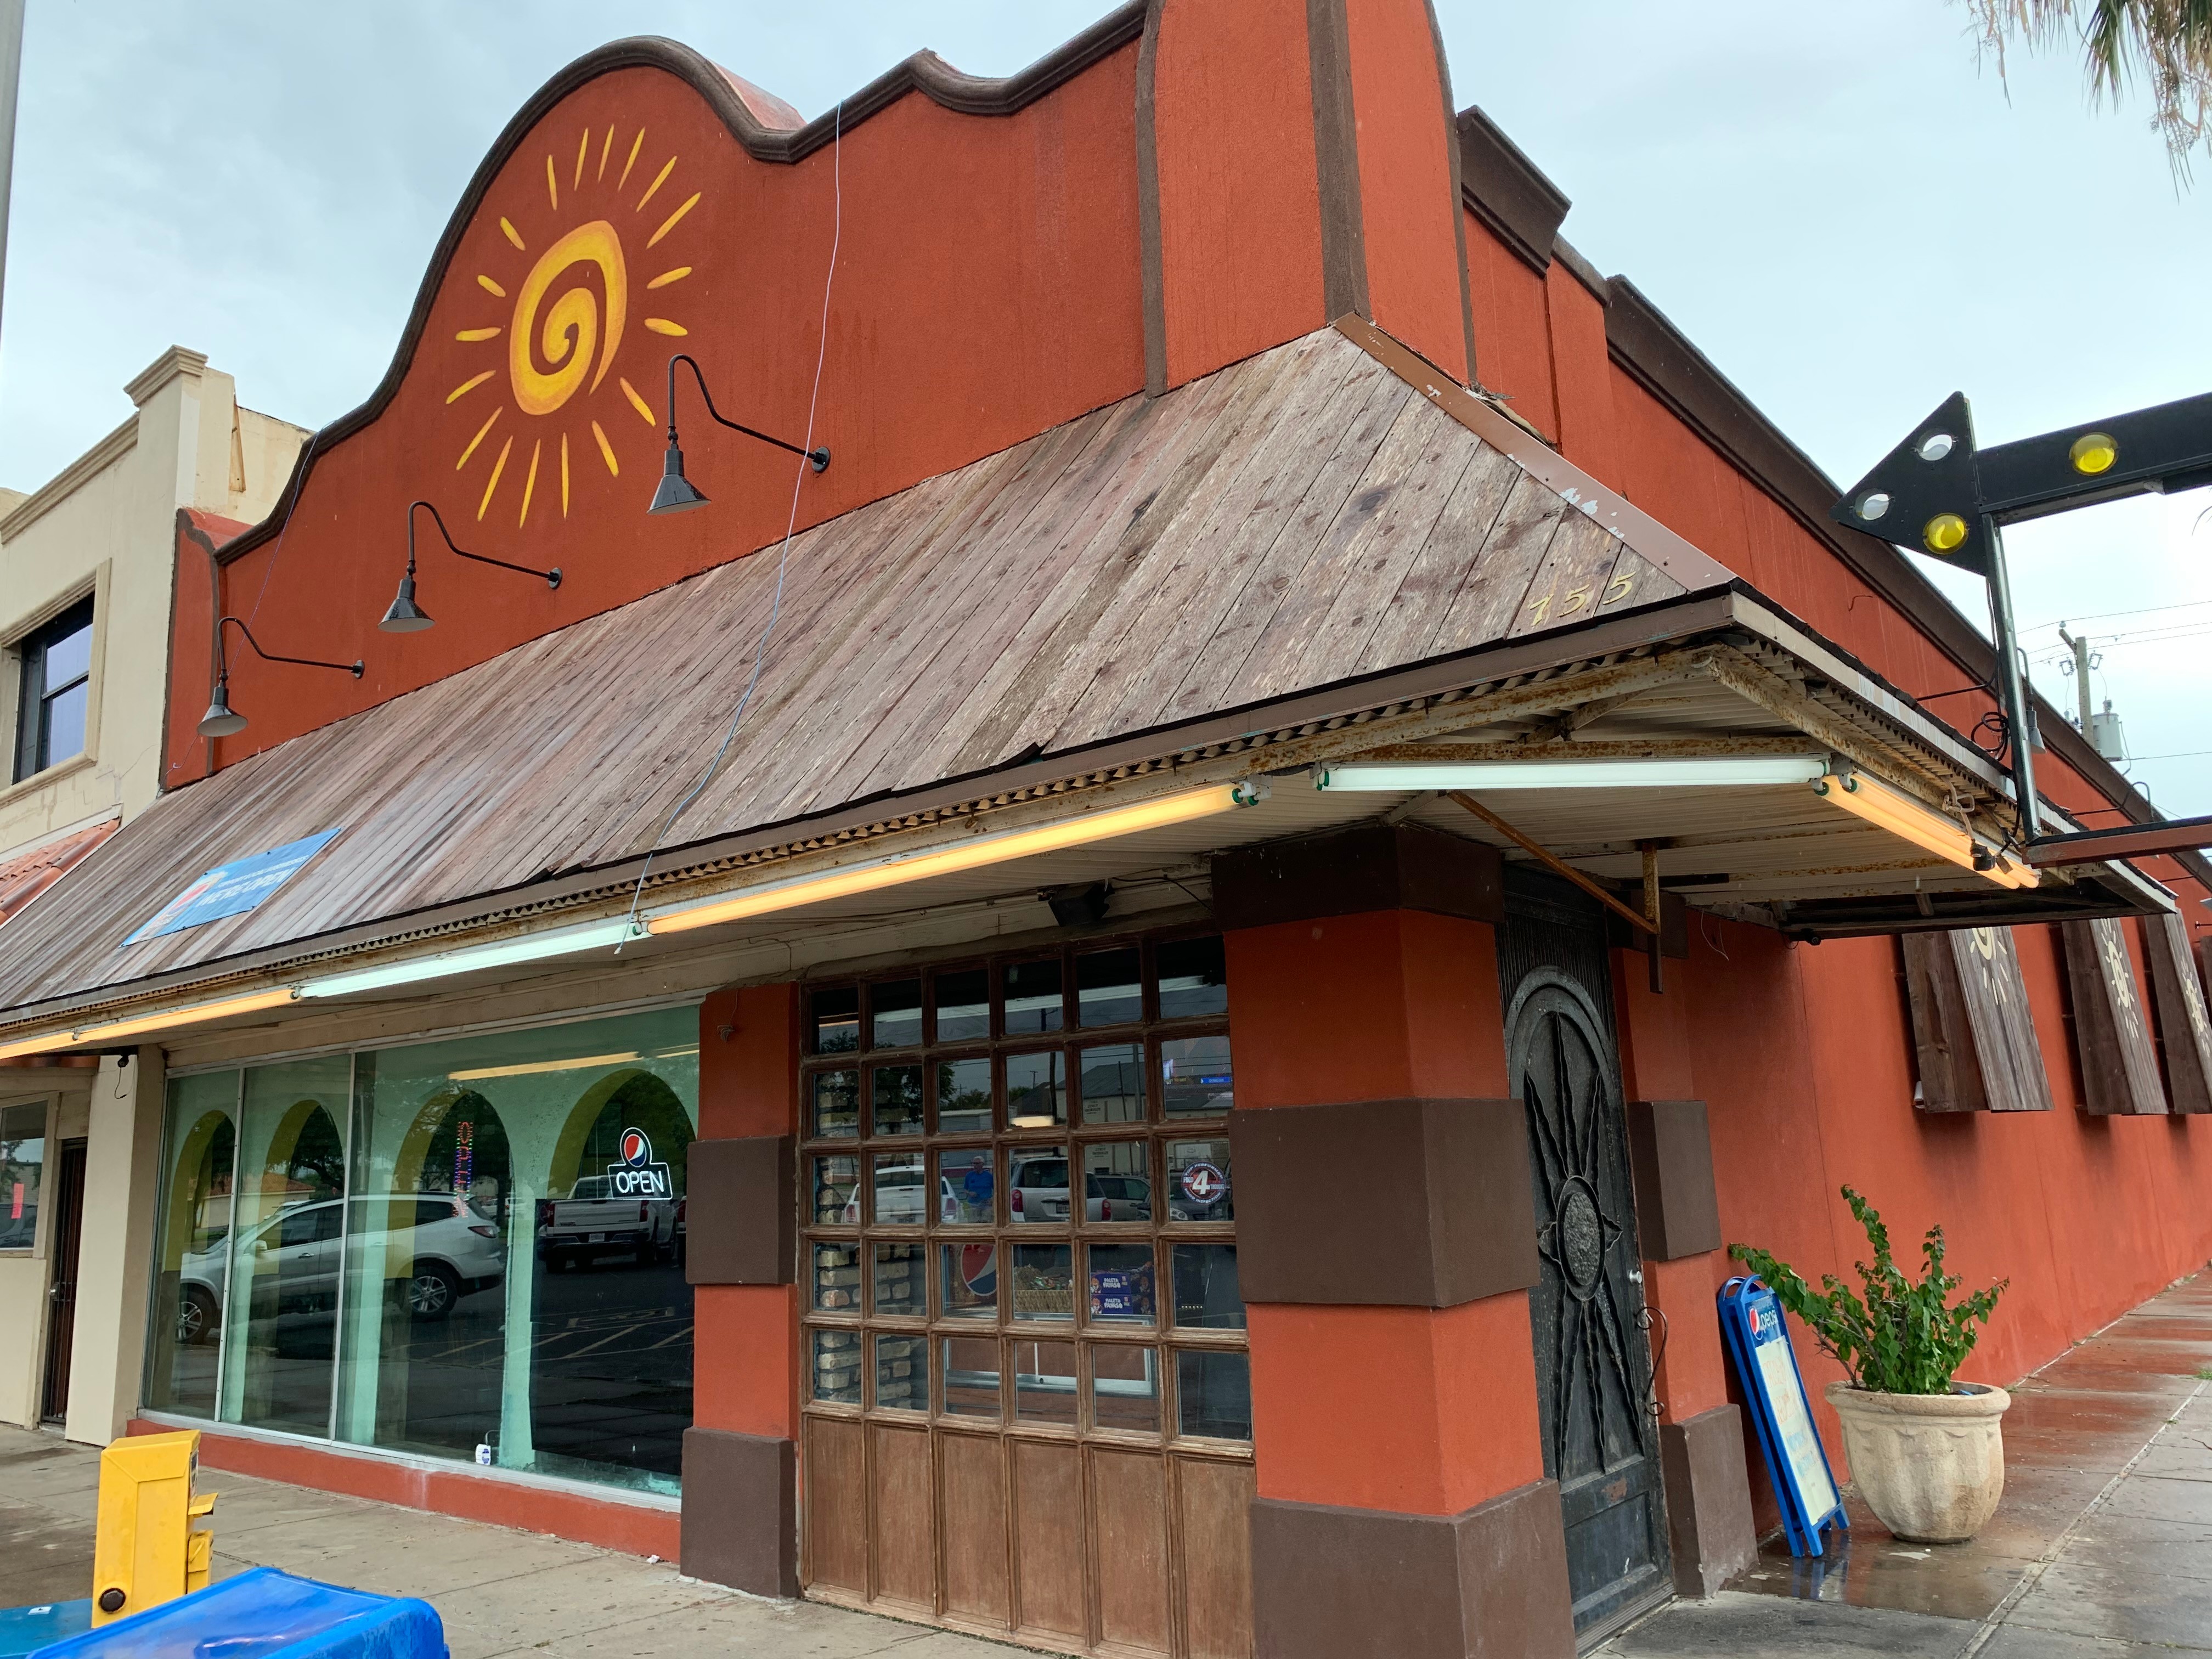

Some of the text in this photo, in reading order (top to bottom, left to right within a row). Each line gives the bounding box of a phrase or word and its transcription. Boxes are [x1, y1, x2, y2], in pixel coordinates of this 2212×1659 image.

[616, 1170, 664, 1194] OPEN
[1192, 1170, 1211, 1195] 4
[1760, 1305, 1778, 1334] pepsi
